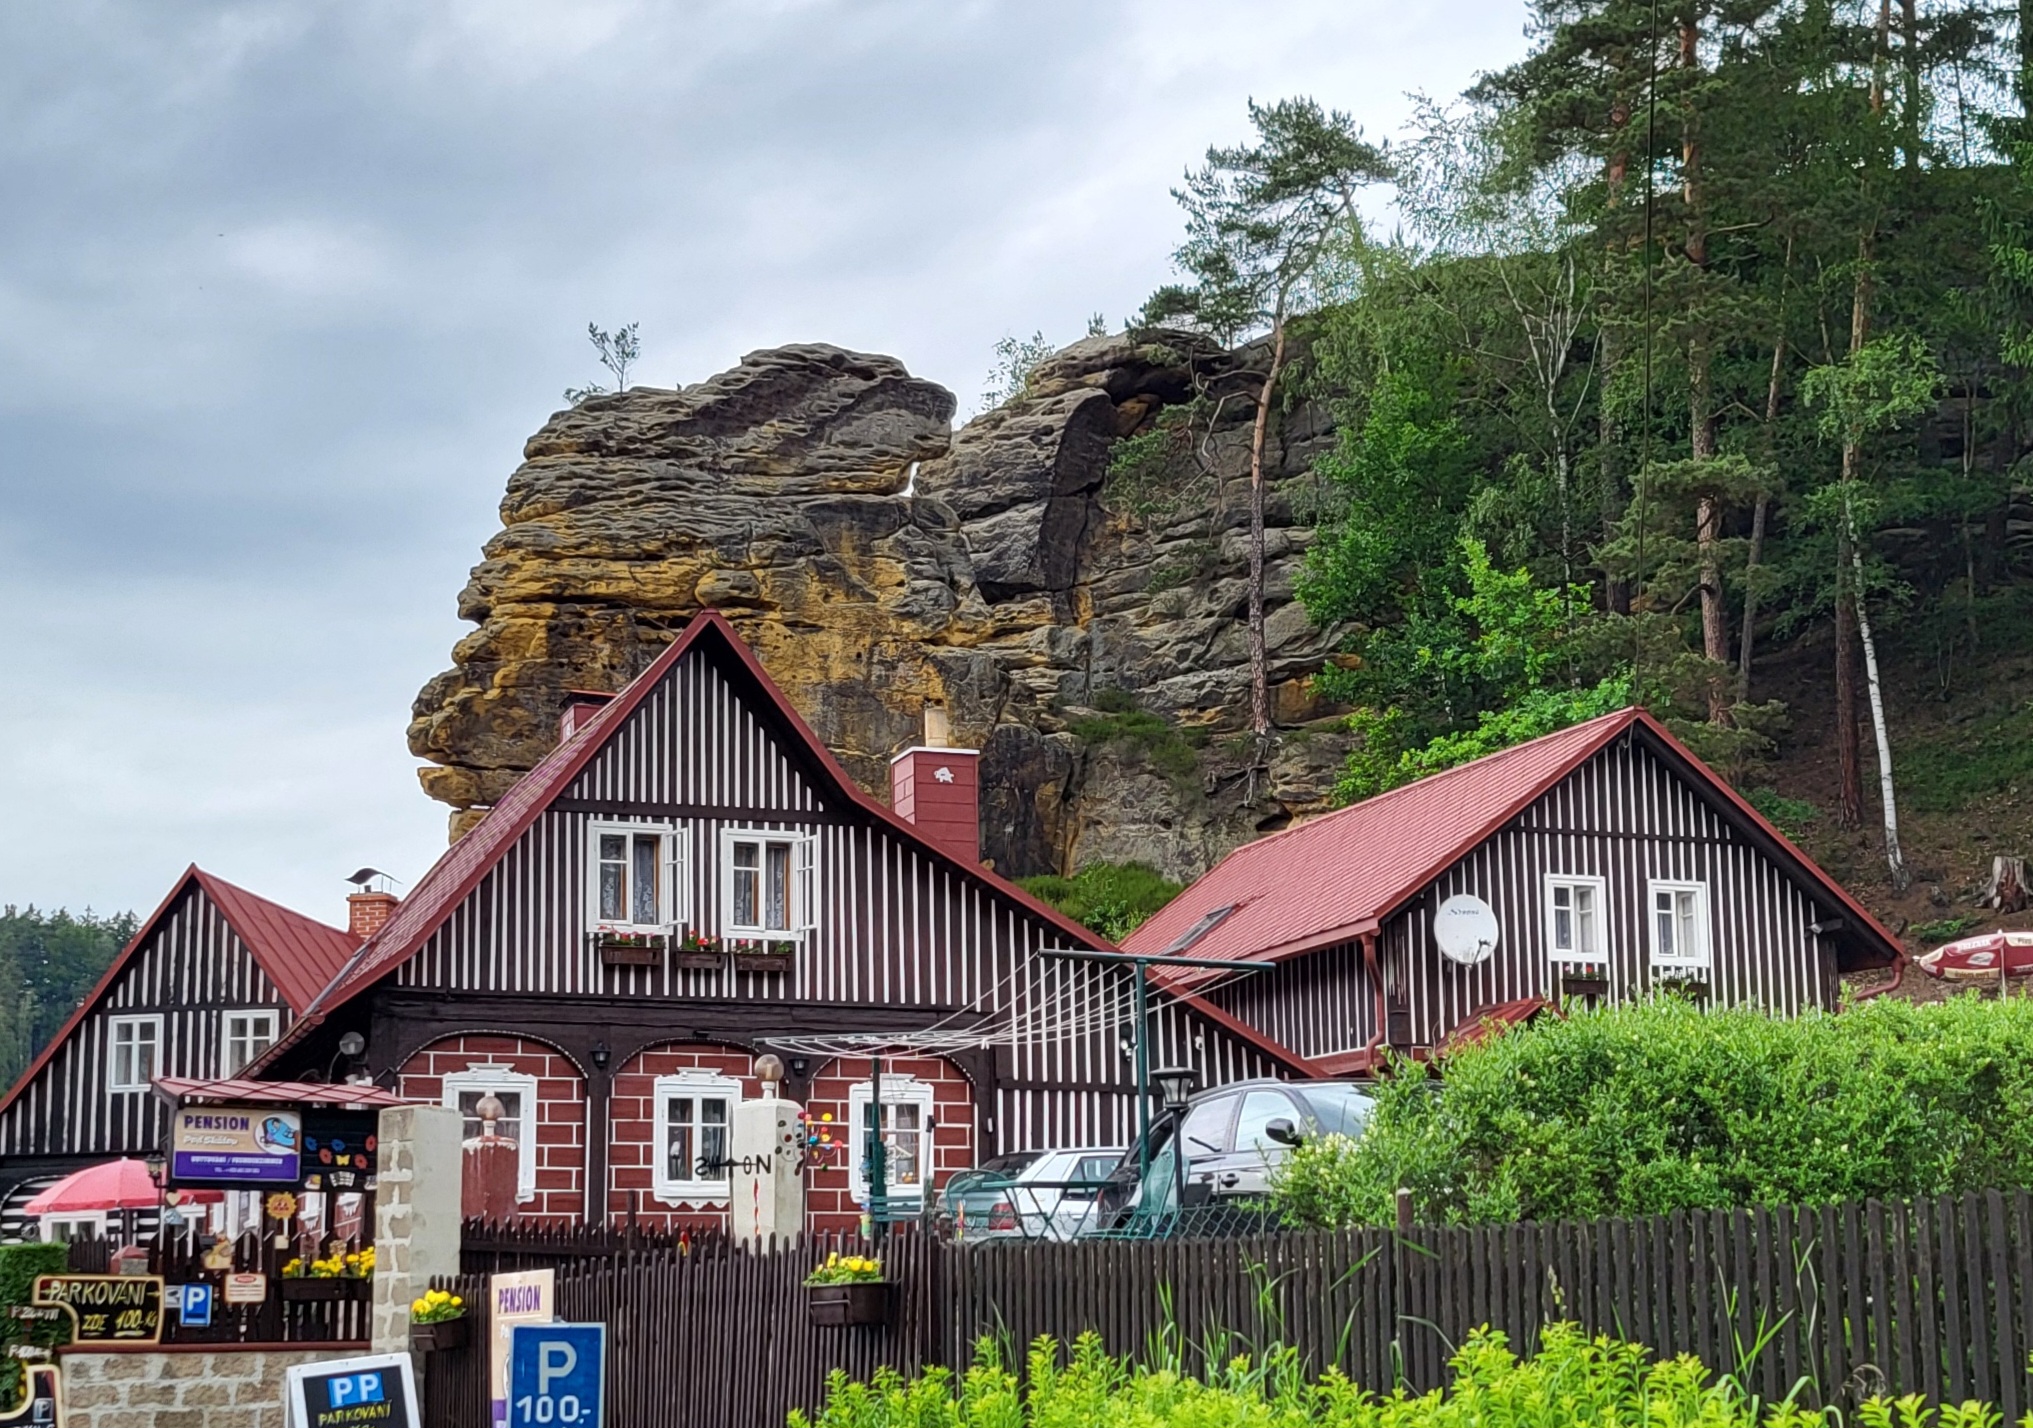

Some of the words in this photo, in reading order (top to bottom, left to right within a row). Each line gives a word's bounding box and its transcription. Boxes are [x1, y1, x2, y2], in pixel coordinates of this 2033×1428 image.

[184, 1115, 250, 1131] PENSION
[186, 1286, 206, 1312] P
[497, 1285, 542, 1314] PENSION
[82, 1314, 110, 1331] ZDE
[539, 1341, 578, 1395] P
[334, 1378, 353, 1405] P
[359, 1374, 379, 1402] P
